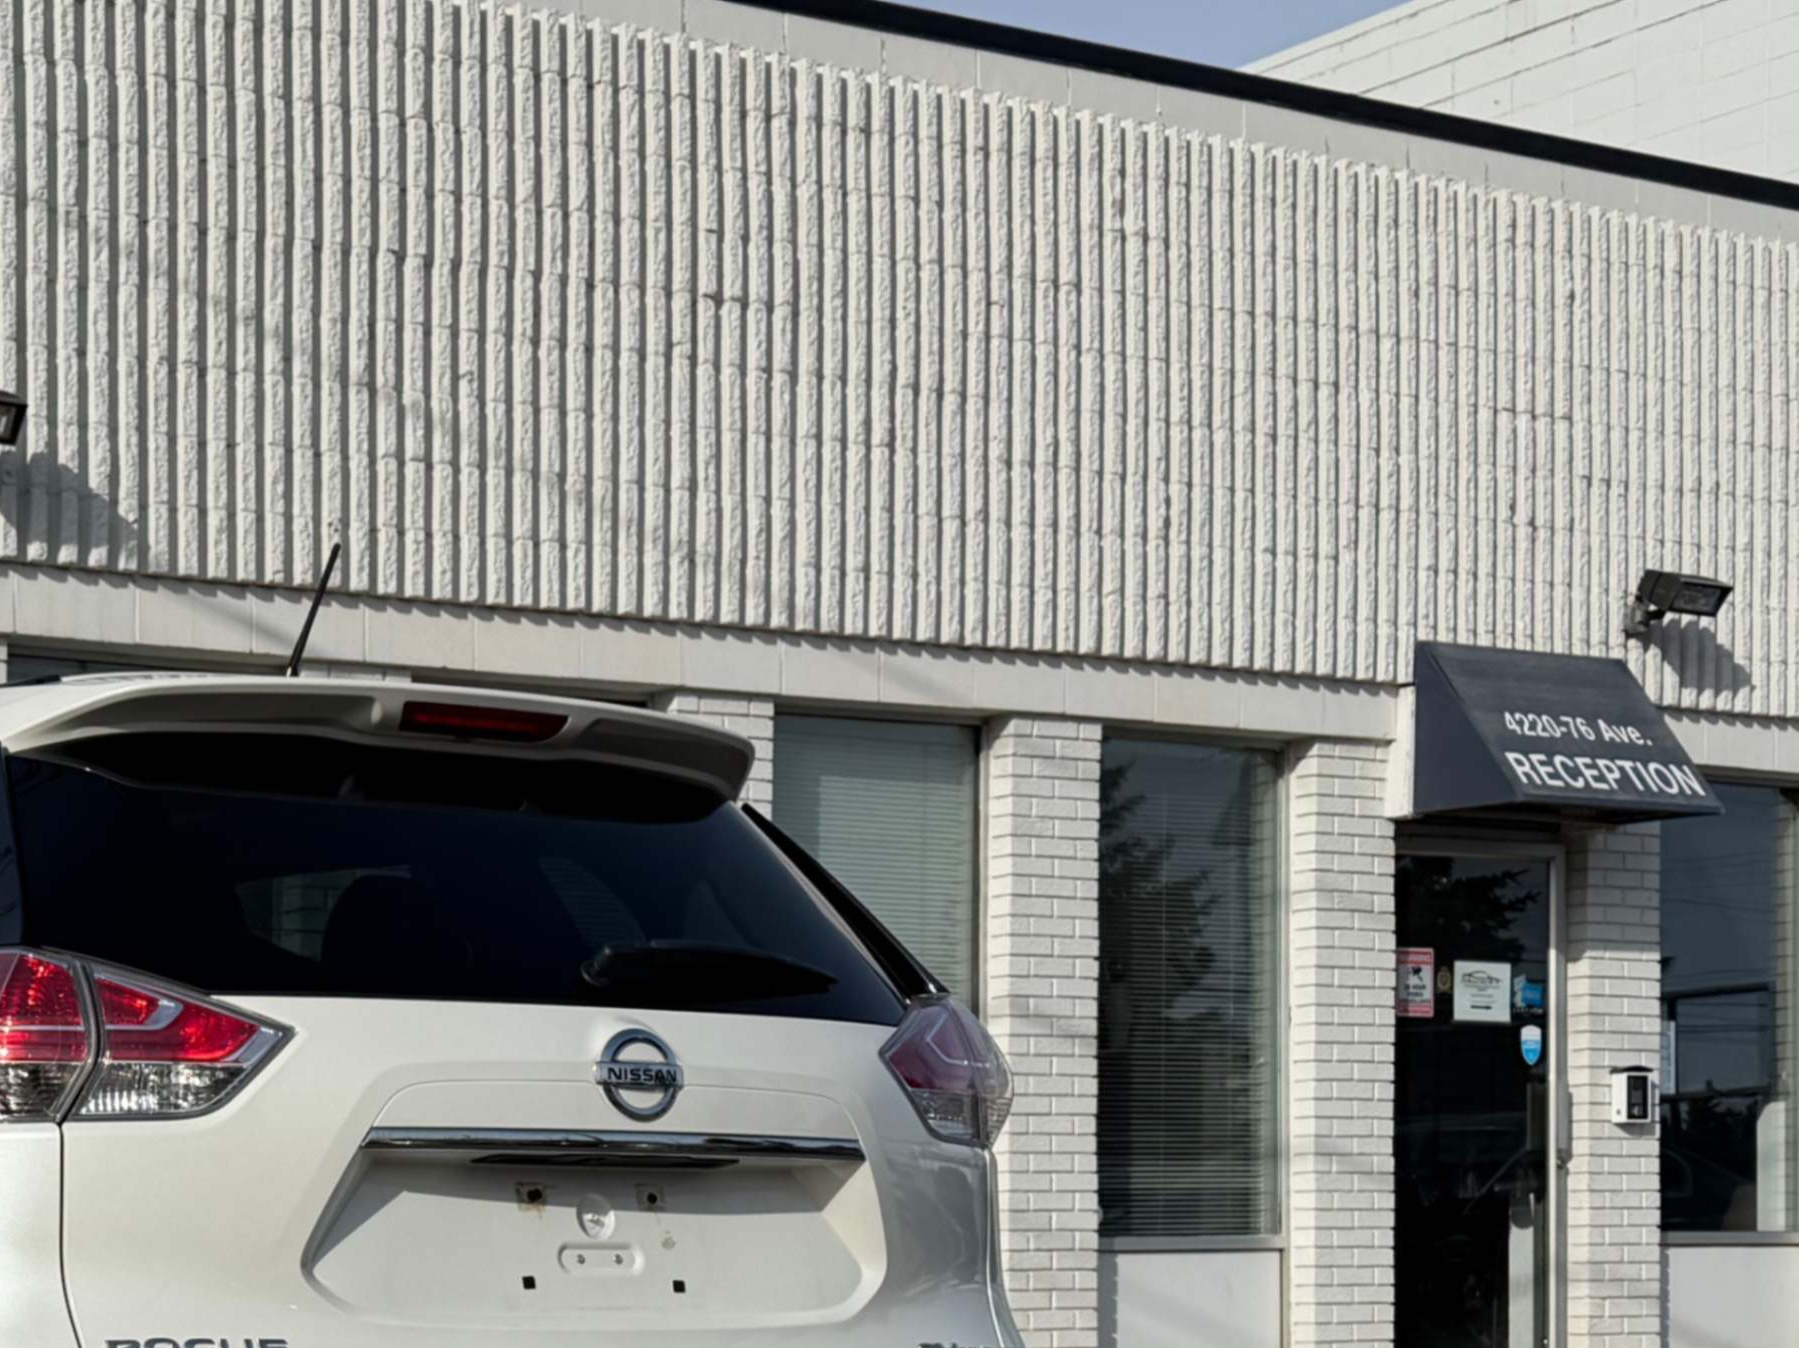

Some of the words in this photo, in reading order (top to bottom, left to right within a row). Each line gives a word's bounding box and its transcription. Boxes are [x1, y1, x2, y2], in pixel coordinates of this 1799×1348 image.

[1504, 711, 1596, 741] 4220-76
[1597, 719, 1653, 746] Ave.
[1504, 751, 1706, 796] RECEPTION
[607, 1067, 678, 1084] NISSAN
